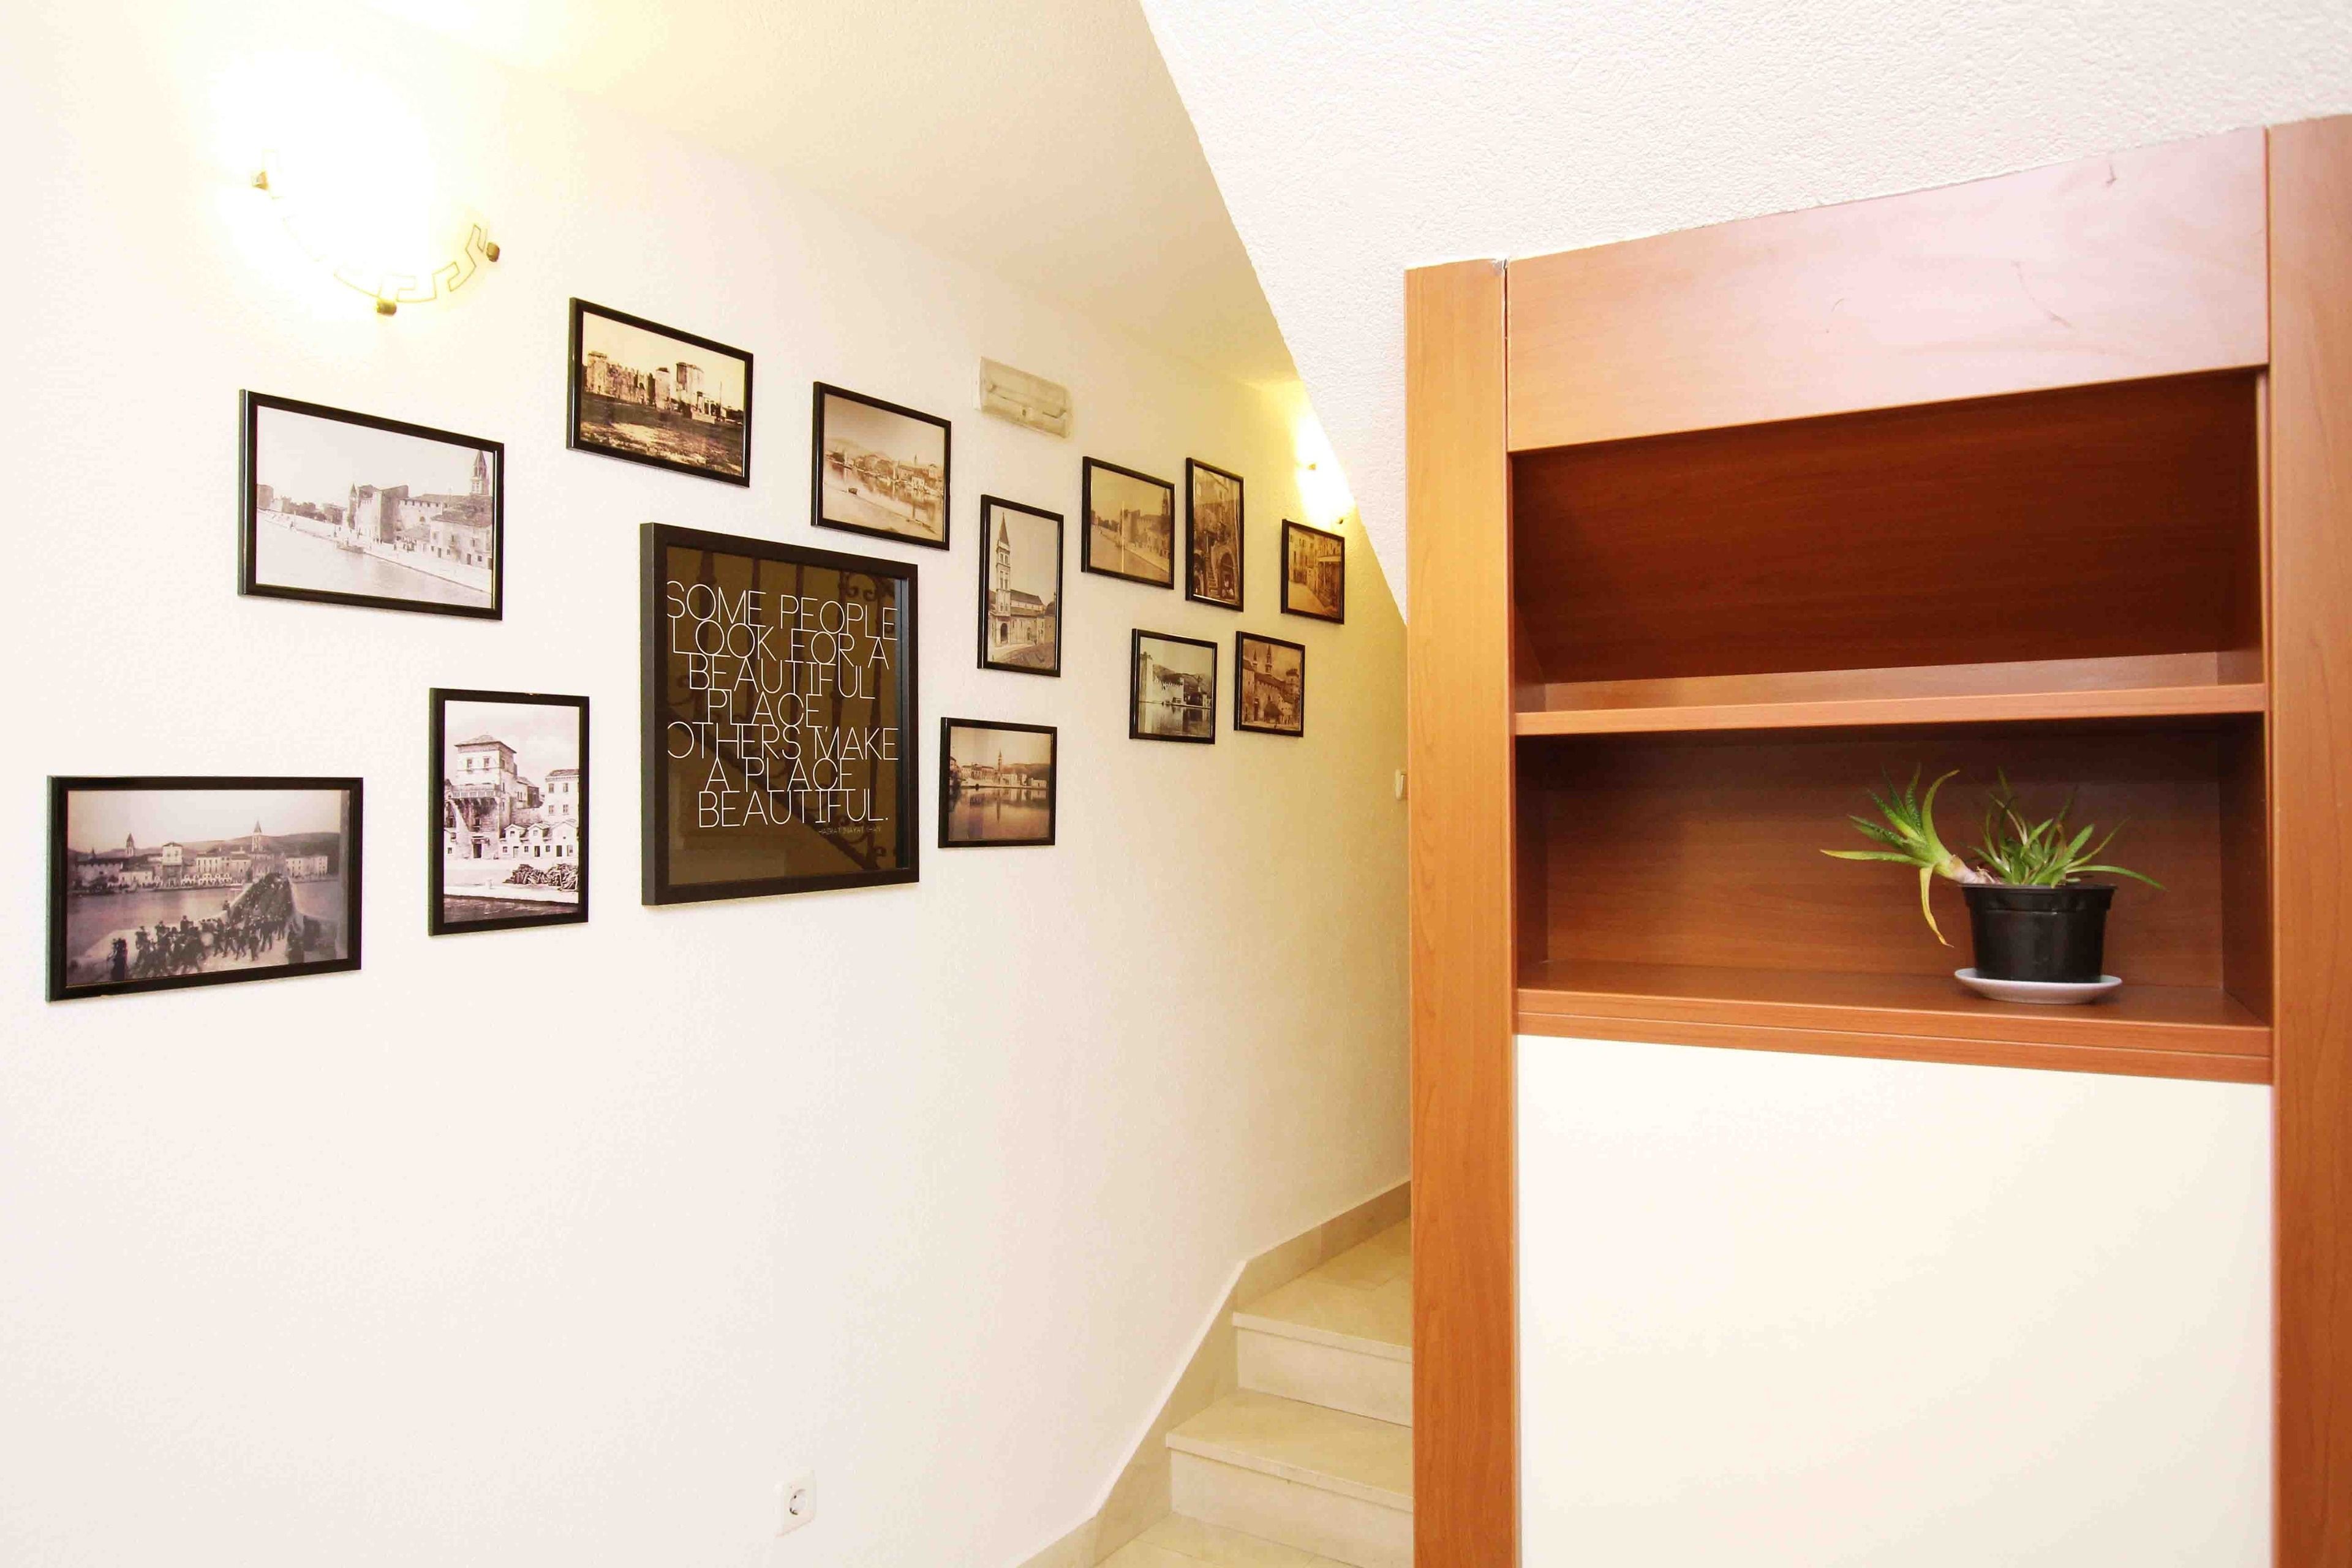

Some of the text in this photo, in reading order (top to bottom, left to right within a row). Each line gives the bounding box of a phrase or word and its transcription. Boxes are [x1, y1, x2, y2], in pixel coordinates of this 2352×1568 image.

[667, 581, 898, 641] SOME PEOPLE
[673, 617, 889, 670] LOOK FOR A
[689, 652, 875, 699] BEAUTIFUL
[667, 721, 899, 760] OTHERS MAKE
[704, 756, 856, 793] A PLACE
[698, 788, 889, 828] BEAUTIFUL.
